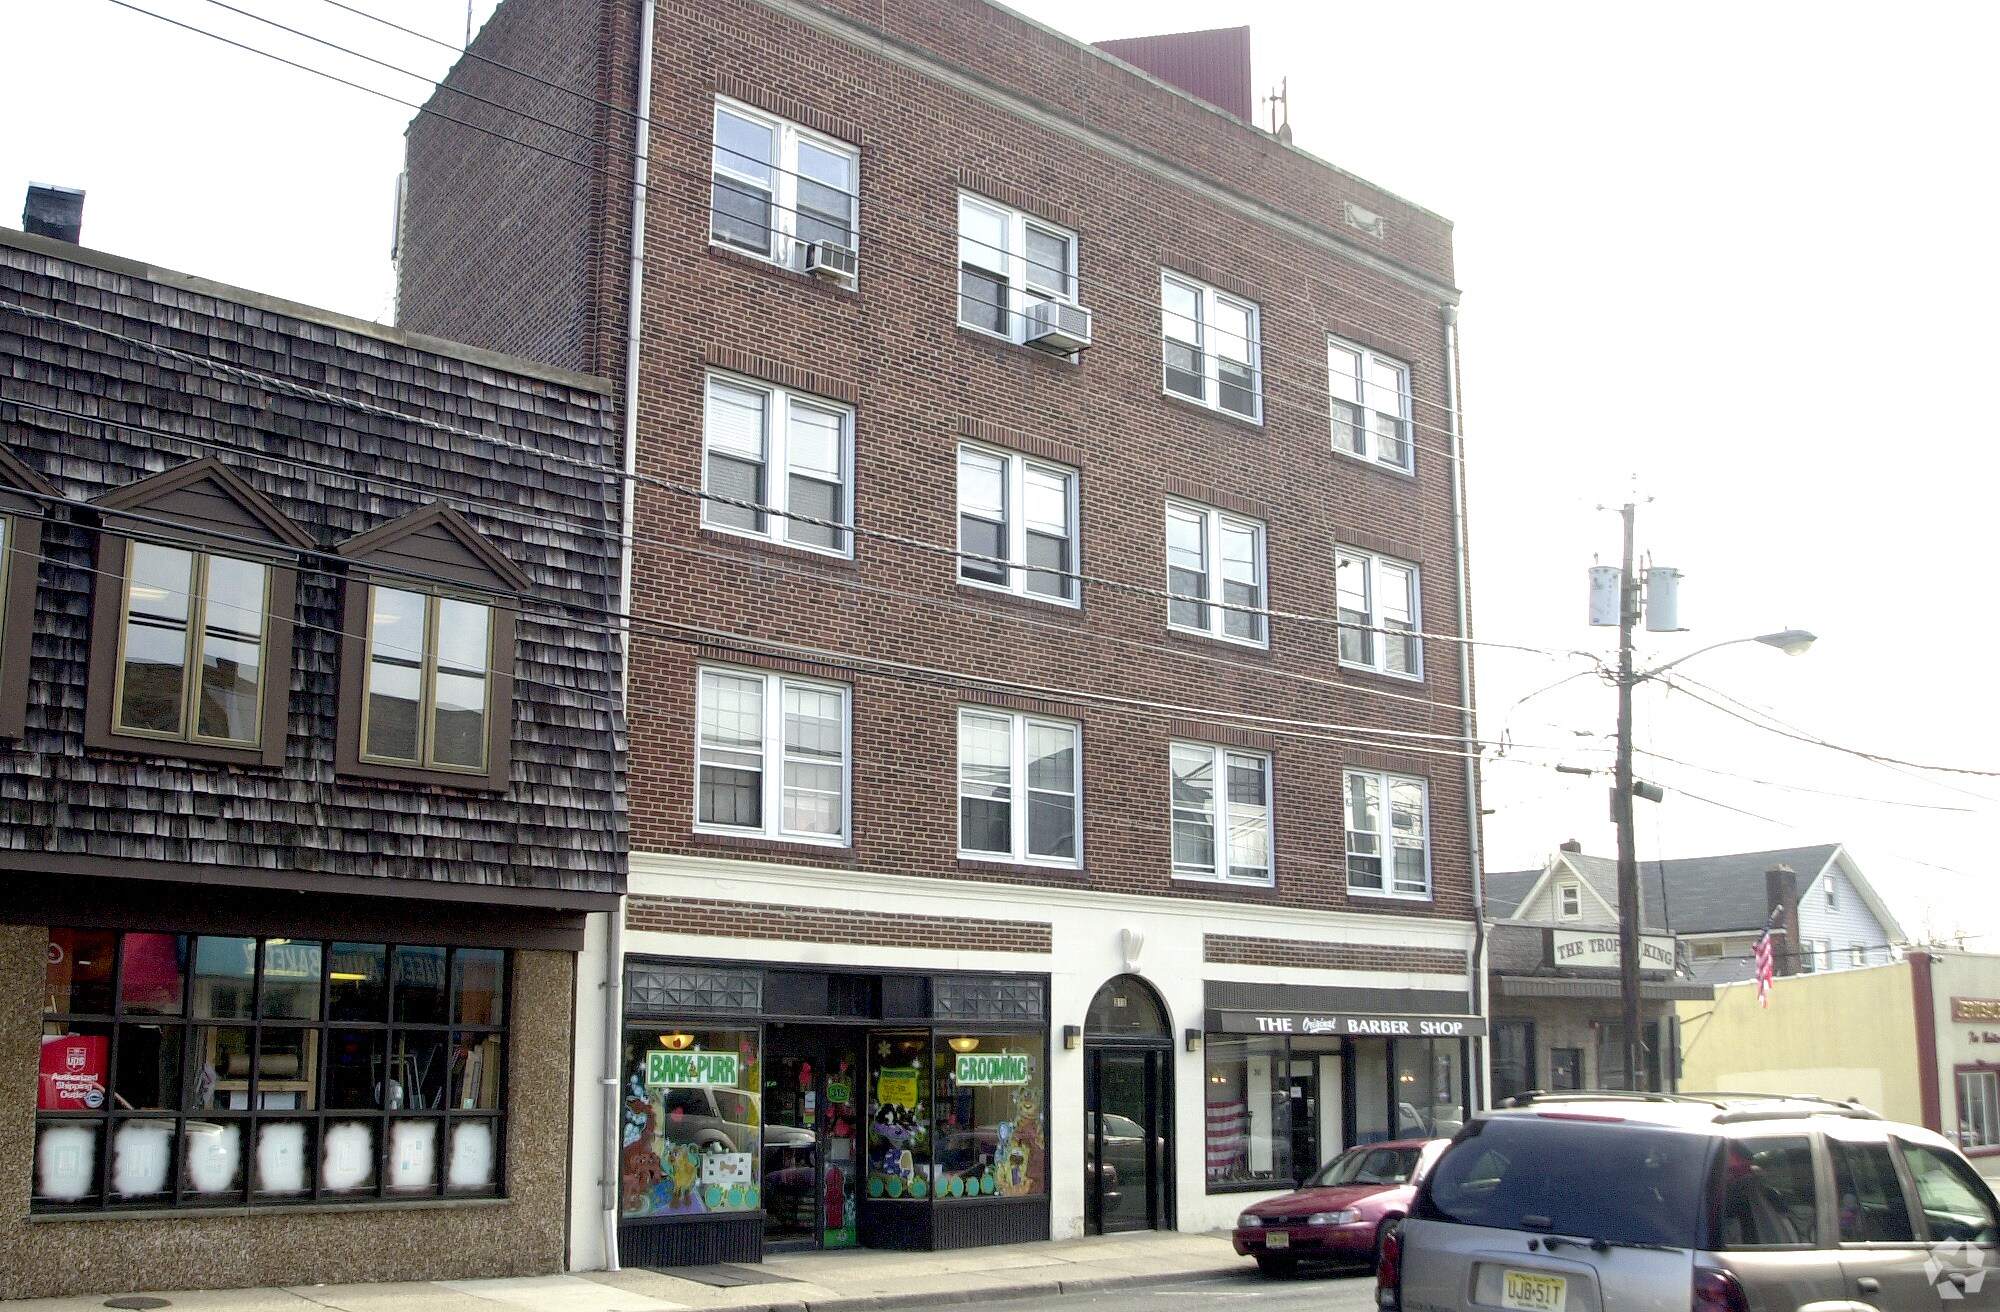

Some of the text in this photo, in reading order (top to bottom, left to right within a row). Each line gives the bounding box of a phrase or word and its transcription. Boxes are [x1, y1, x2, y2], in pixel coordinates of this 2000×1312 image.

[1557, 941, 1584, 960] THE
[1643, 943, 1673, 965] KING
[1256, 1017, 1293, 1031] THE
[1348, 1019, 1411, 1034] BARBER
[1420, 1021, 1463, 1035] SHOP
[52, 1073, 98, 1082] Authorized
[650, 1055, 736, 1083] BARK PURR
[958, 1055, 1027, 1081] GROOMING
[56, 1082, 93, 1091] Shipping
